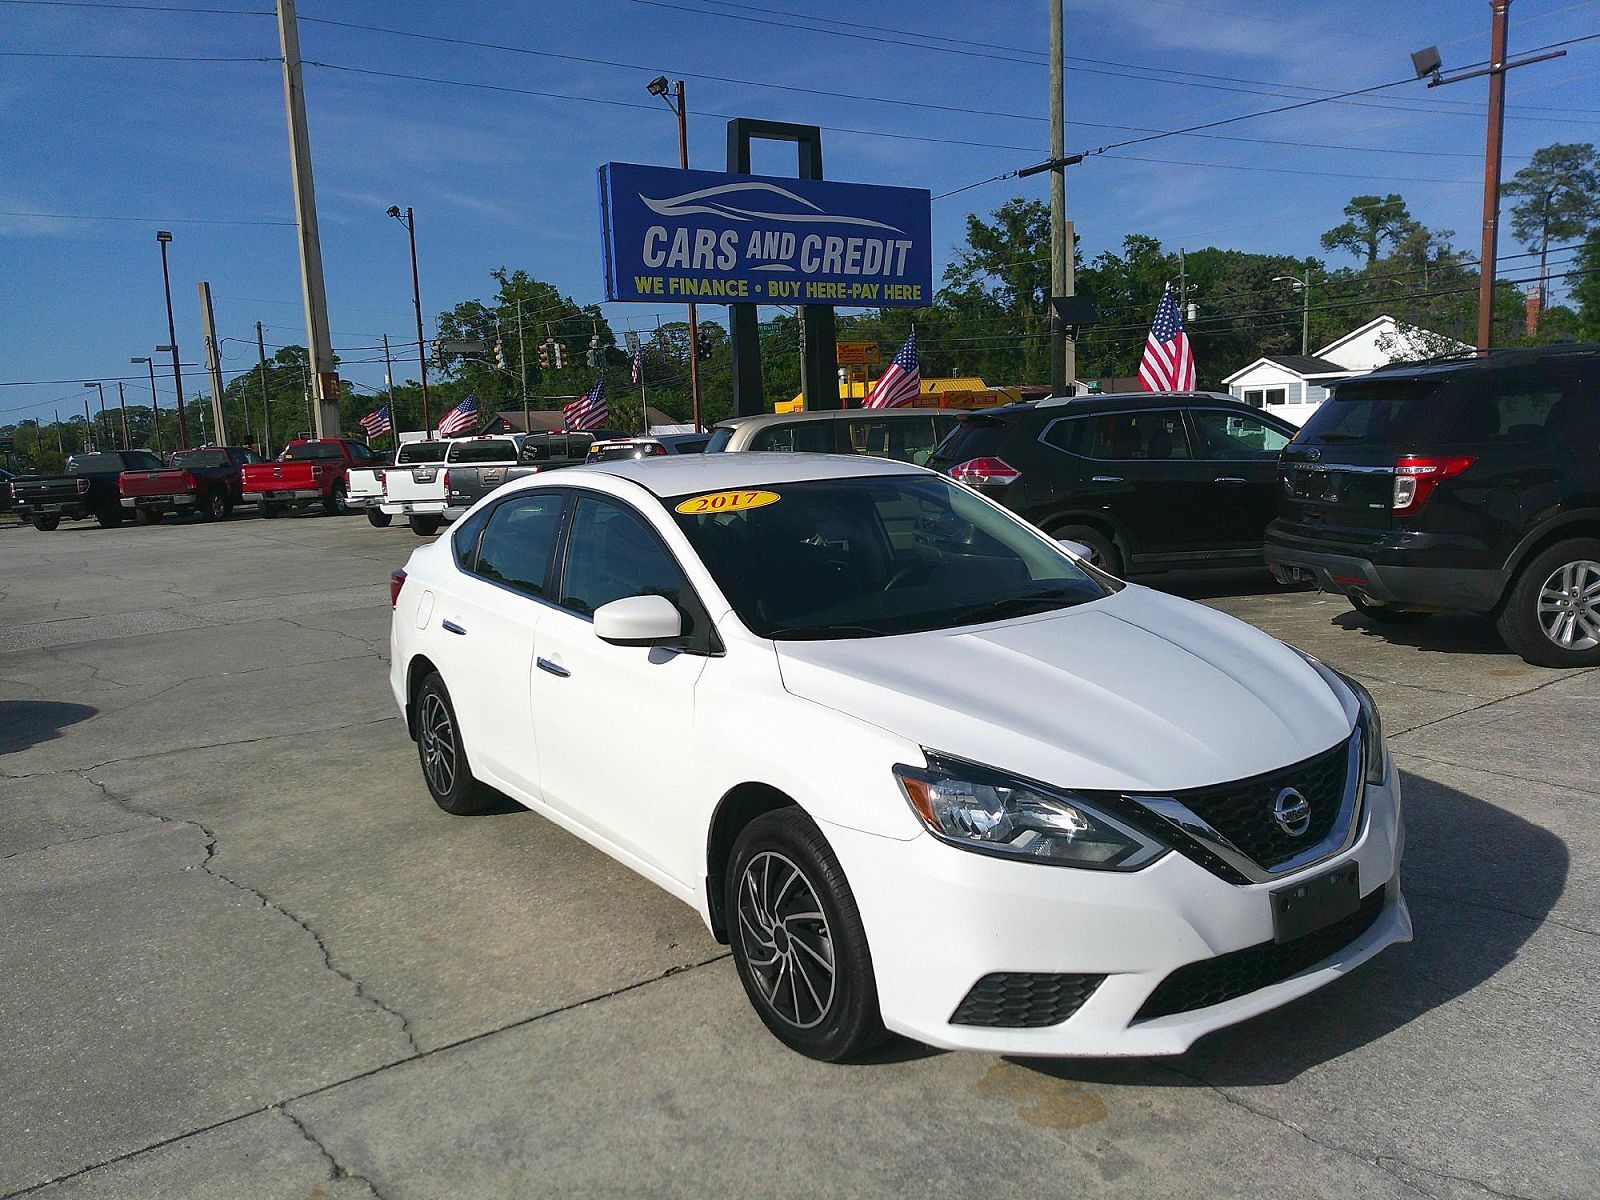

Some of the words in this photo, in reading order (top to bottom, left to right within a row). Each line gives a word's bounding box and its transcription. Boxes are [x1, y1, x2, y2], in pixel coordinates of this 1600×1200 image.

[643, 226, 738, 270] CARS
[746, 231, 796, 260] AND
[801, 234, 912, 276] CREDIT
[634, 276, 664, 294] WE
[669, 278, 749, 297] FINANCE
[768, 281, 801, 298] BUY
[806, 282, 880, 300] HERE-PAY
[884, 284, 922, 300] HERE
[695, 492, 759, 511] 2017
